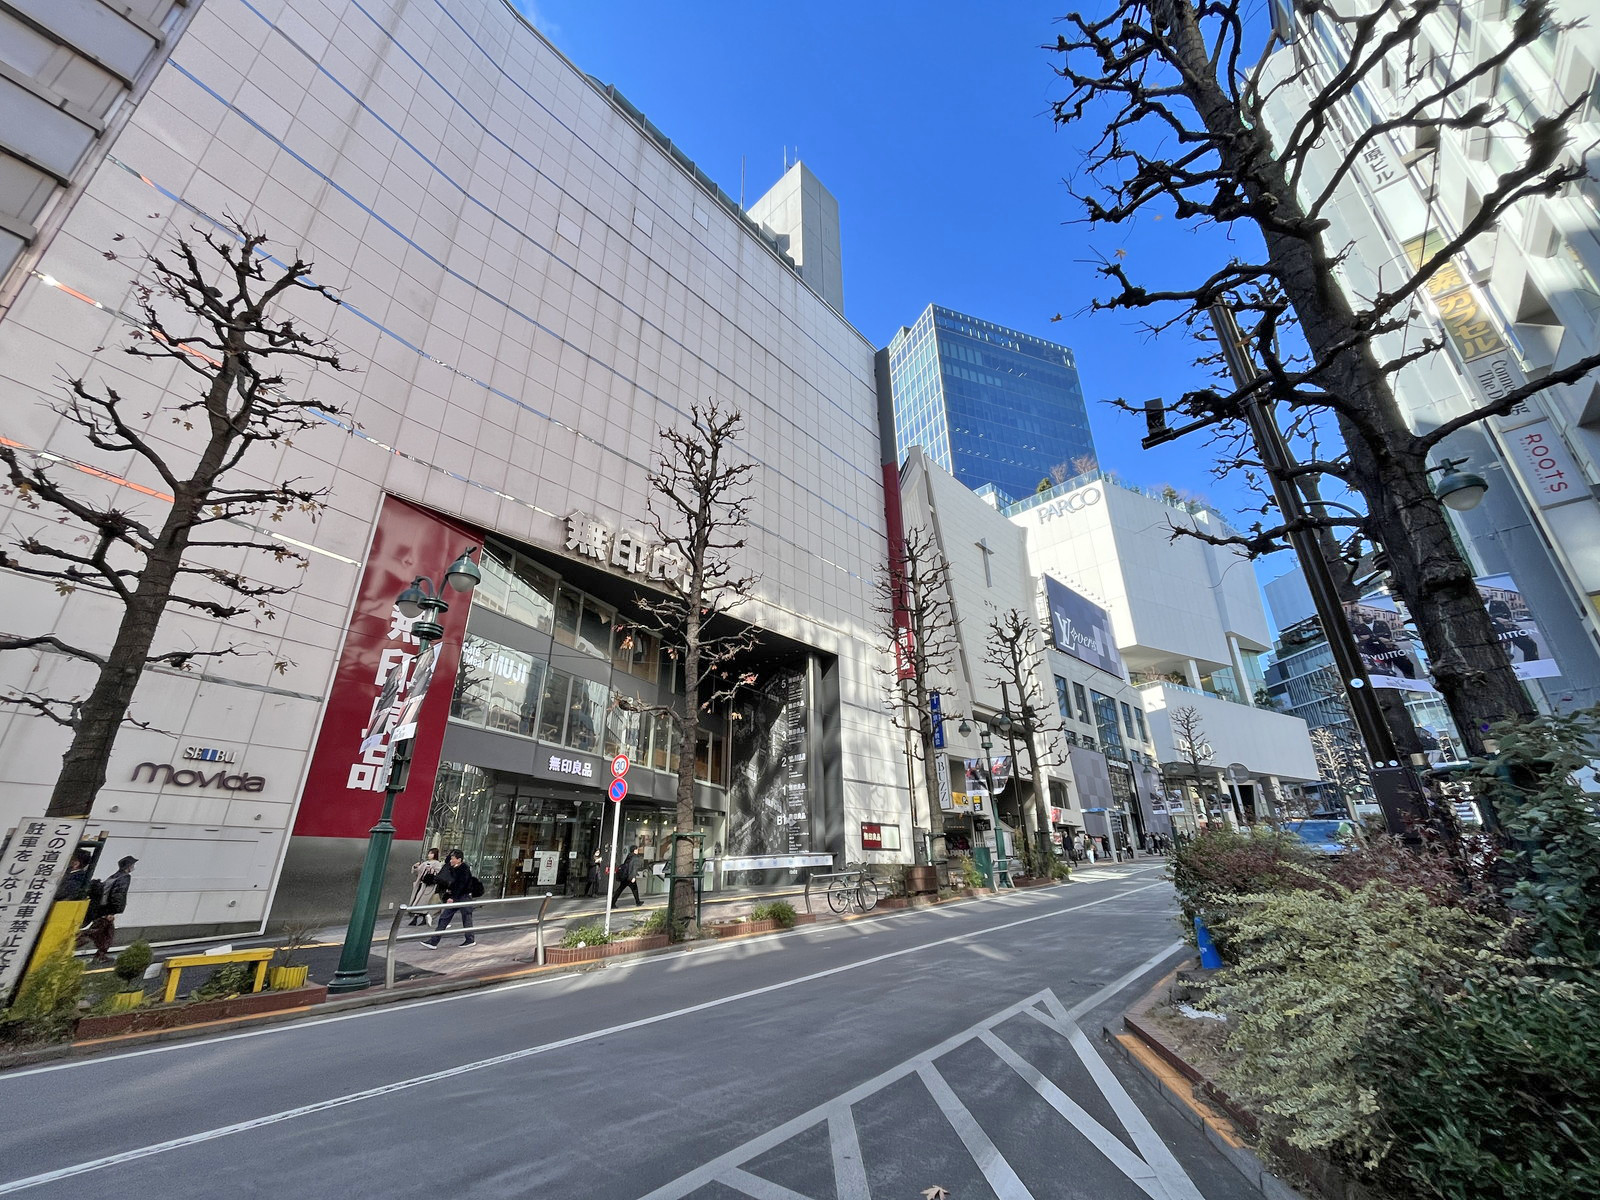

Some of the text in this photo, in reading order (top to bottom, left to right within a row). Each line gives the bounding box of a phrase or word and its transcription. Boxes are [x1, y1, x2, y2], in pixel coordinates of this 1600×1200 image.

[1491, 359, 1530, 416] Conneng
[1036, 487, 1101, 525] PARCO
[1497, 628, 1540, 641] ITTON
[1370, 648, 1415, 661] VUITTON
[781, 730, 787, 742] 3
[182, 746, 238, 764] SEIBU
[781, 756, 787, 768] 2
[548, 755, 592, 778] 無印良品
[615, 760, 626, 771] 30
[130, 761, 266, 792] movida
